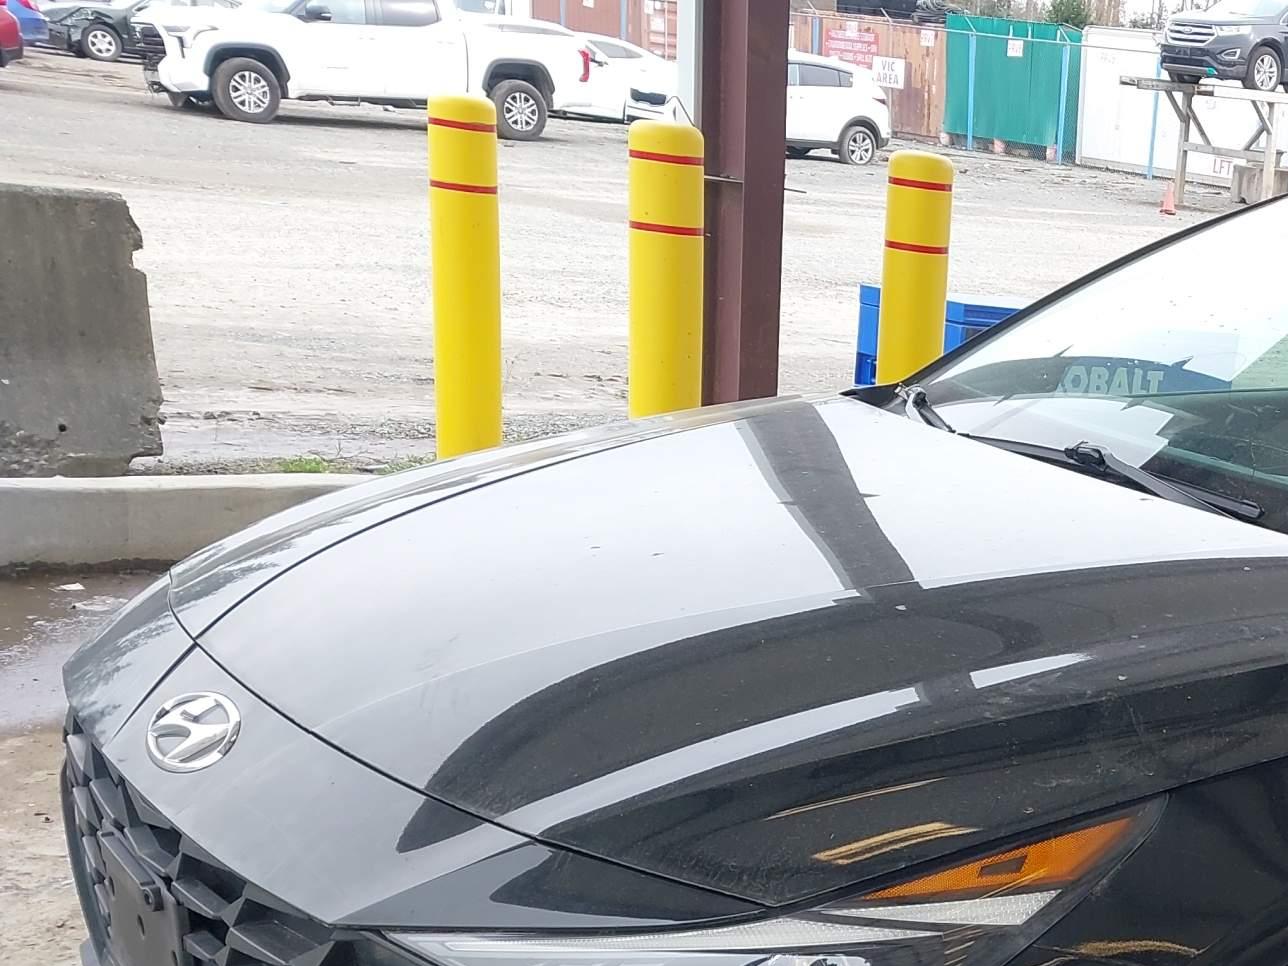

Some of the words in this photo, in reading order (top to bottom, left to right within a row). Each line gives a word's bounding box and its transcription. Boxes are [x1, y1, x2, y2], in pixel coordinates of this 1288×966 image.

[881, 60, 896, 72] VIC
[875, 72, 899, 85] AREA
[1055, 365, 1165, 395] OBALT
